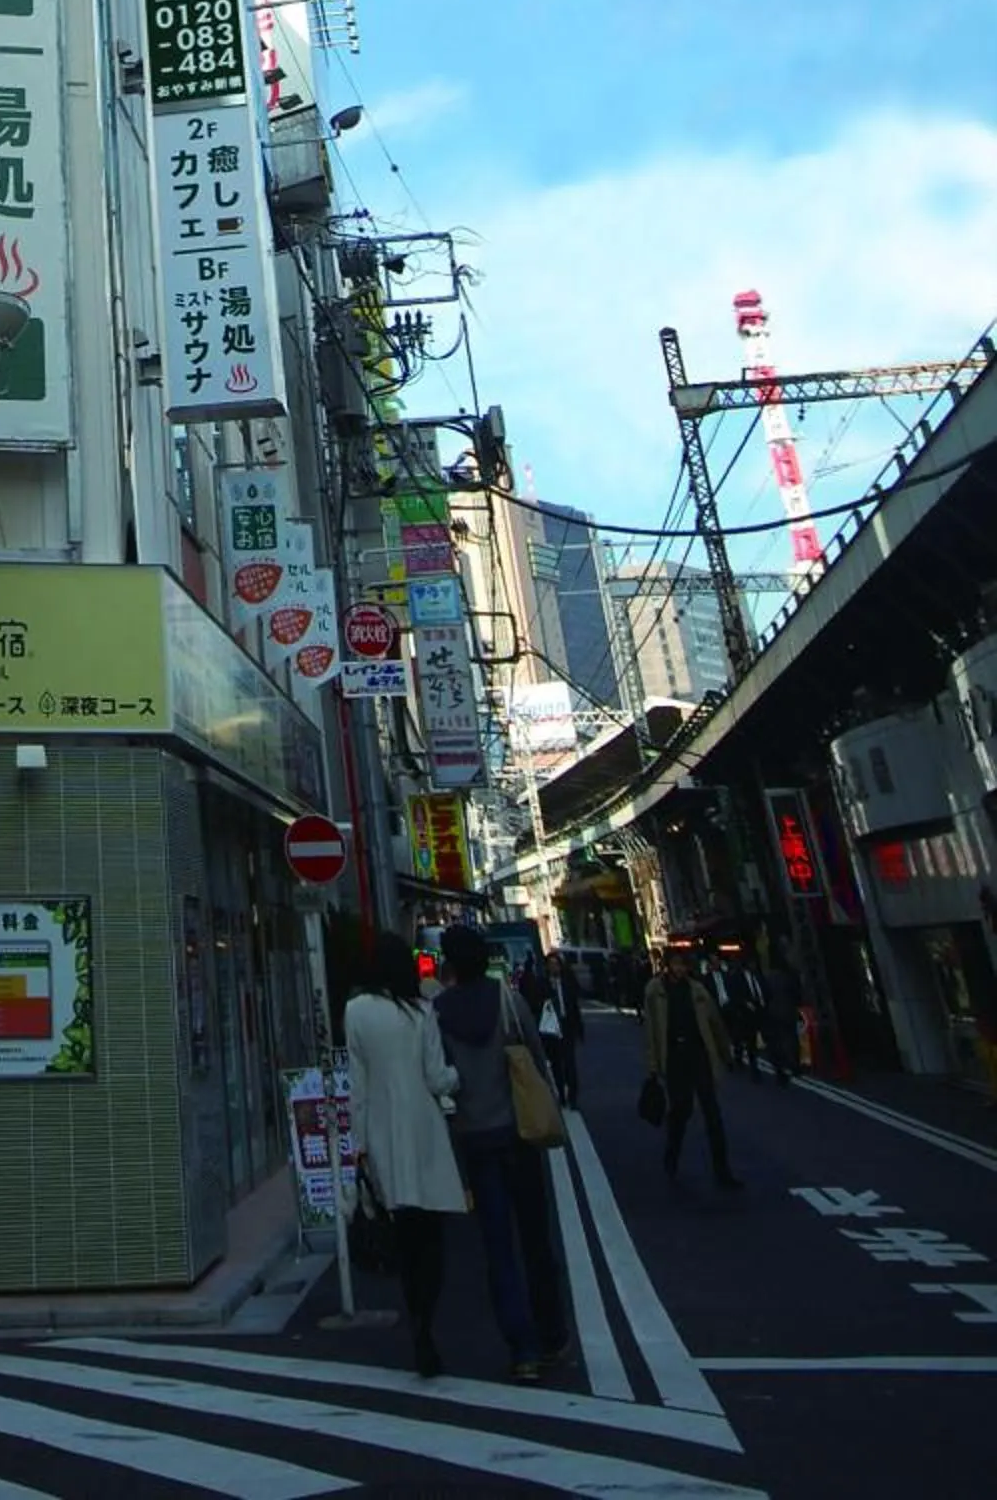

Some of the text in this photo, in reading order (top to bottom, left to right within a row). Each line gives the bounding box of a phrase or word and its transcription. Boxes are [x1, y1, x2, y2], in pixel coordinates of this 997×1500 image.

[155, 0, 233, 29] 0120
[159, 25, 235, 52] -083
[160, 51, 237, 75] -484
[186, 117, 219, 141] 2F
[207, 144, 240, 207] 癒し
[170, 149, 205, 239] カフェ
[197, 257, 229, 281] BF
[174, 292, 214, 309] ミスト
[219, 286, 256, 356] 湯処
[180, 311, 212, 394] サウナ
[349, 625, 389, 644] 消火栓
[59, 695, 157, 717] 深夜コース
